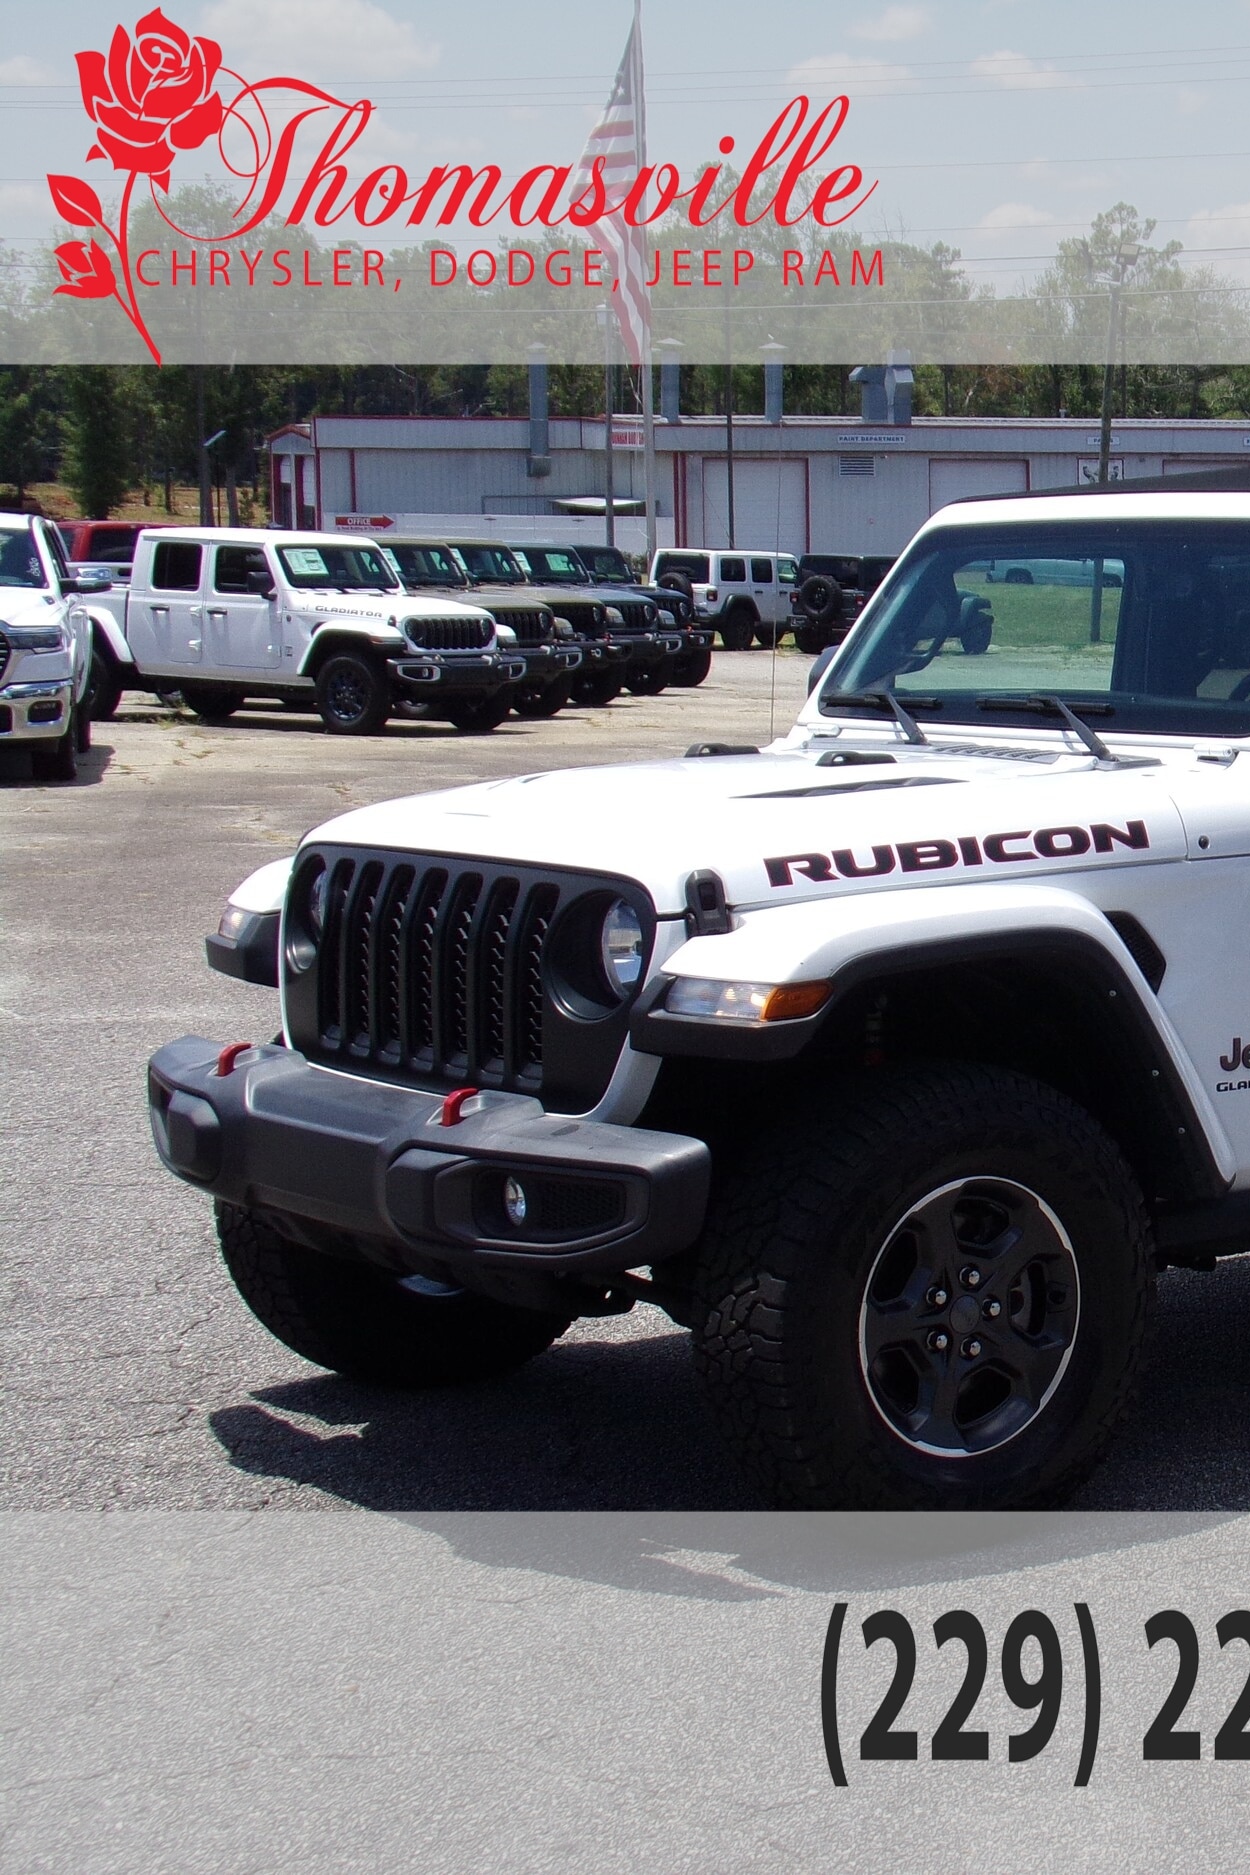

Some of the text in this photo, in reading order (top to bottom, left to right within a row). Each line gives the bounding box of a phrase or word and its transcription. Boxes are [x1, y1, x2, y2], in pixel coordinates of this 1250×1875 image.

[347, 517, 371, 525] OFFICE
[315, 605, 383, 618] GLADIATOR
[762, 819, 1151, 889] RUBICON
